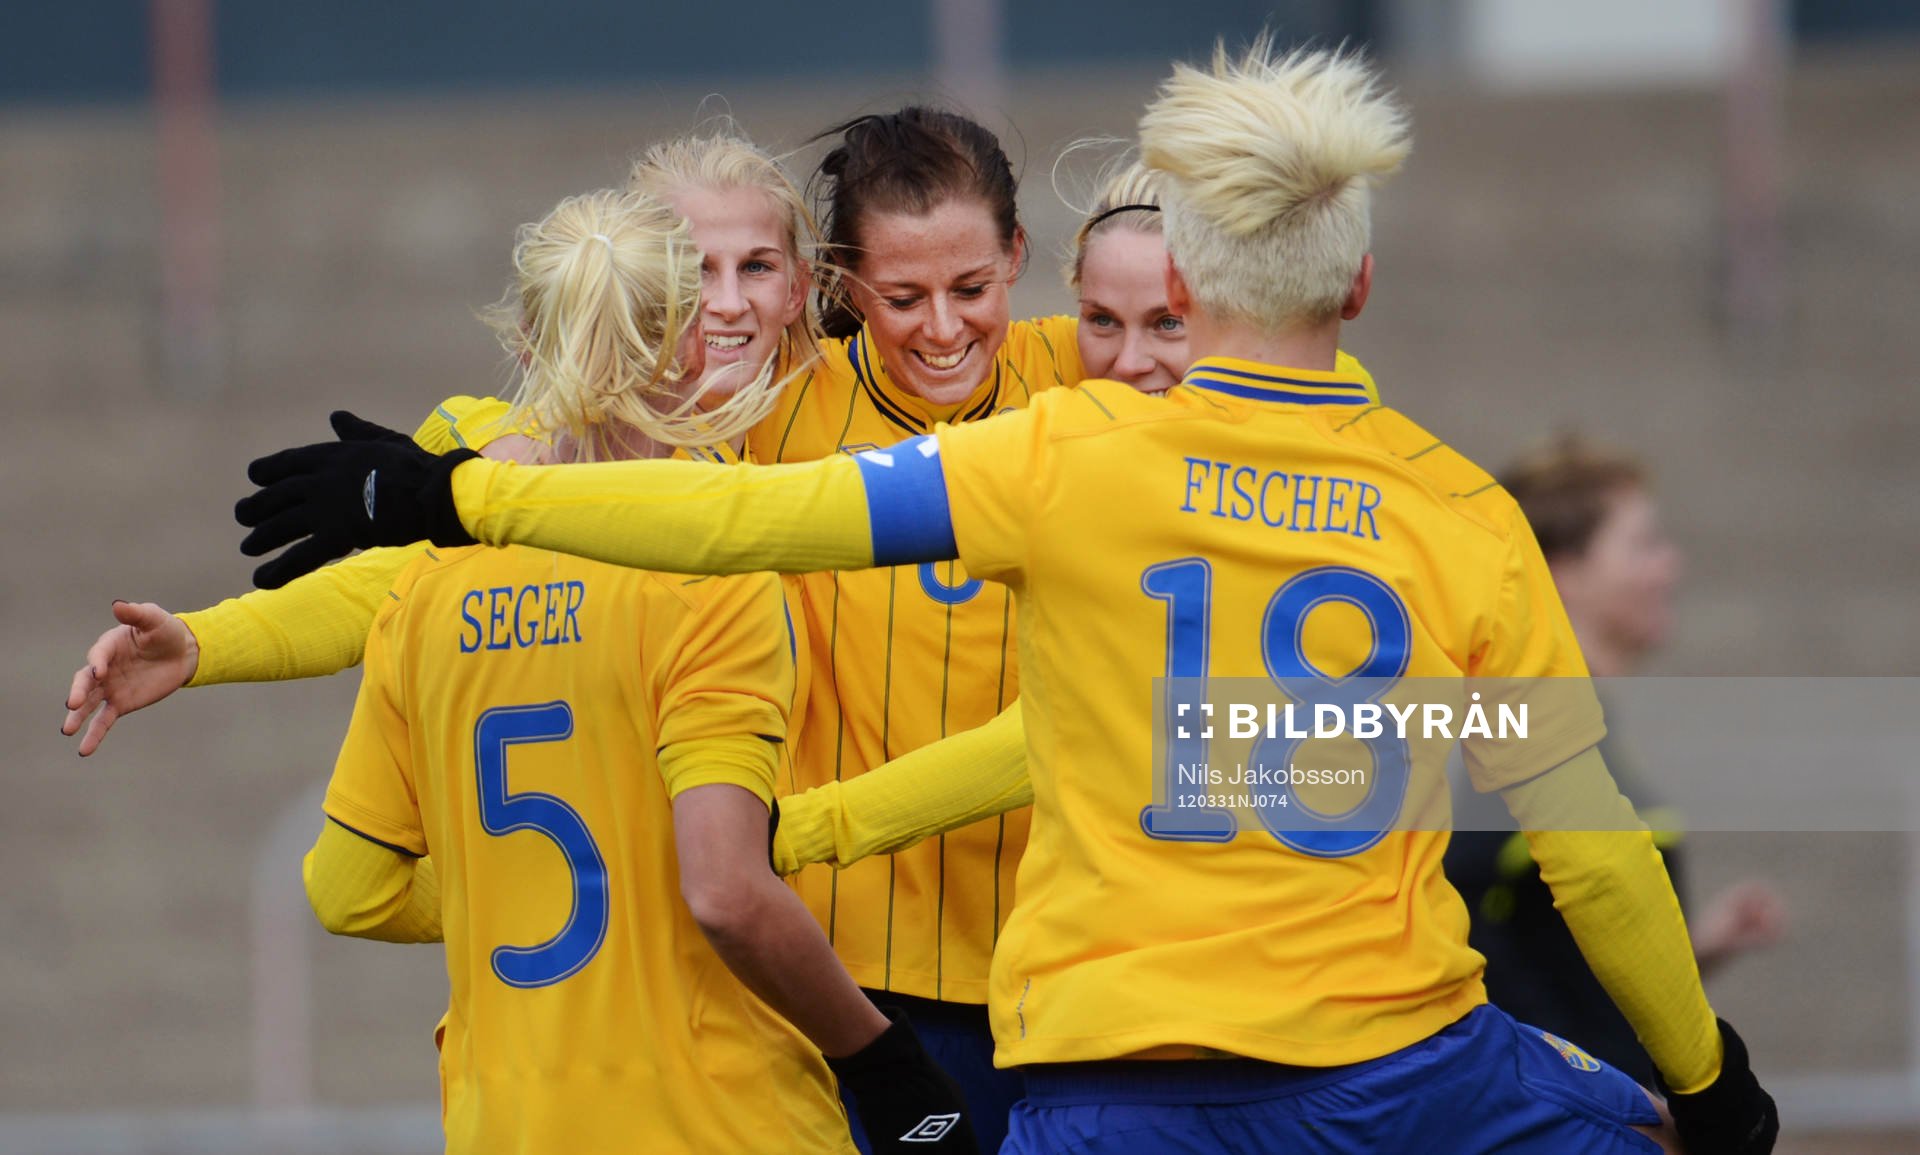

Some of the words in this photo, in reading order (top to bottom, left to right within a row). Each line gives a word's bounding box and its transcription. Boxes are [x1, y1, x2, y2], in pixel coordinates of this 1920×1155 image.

[1179, 456, 1383, 541] FISCHER
[459, 580, 585, 653] SEGER
[1139, 556, 1413, 859] 18
[473, 700, 610, 989] 5
